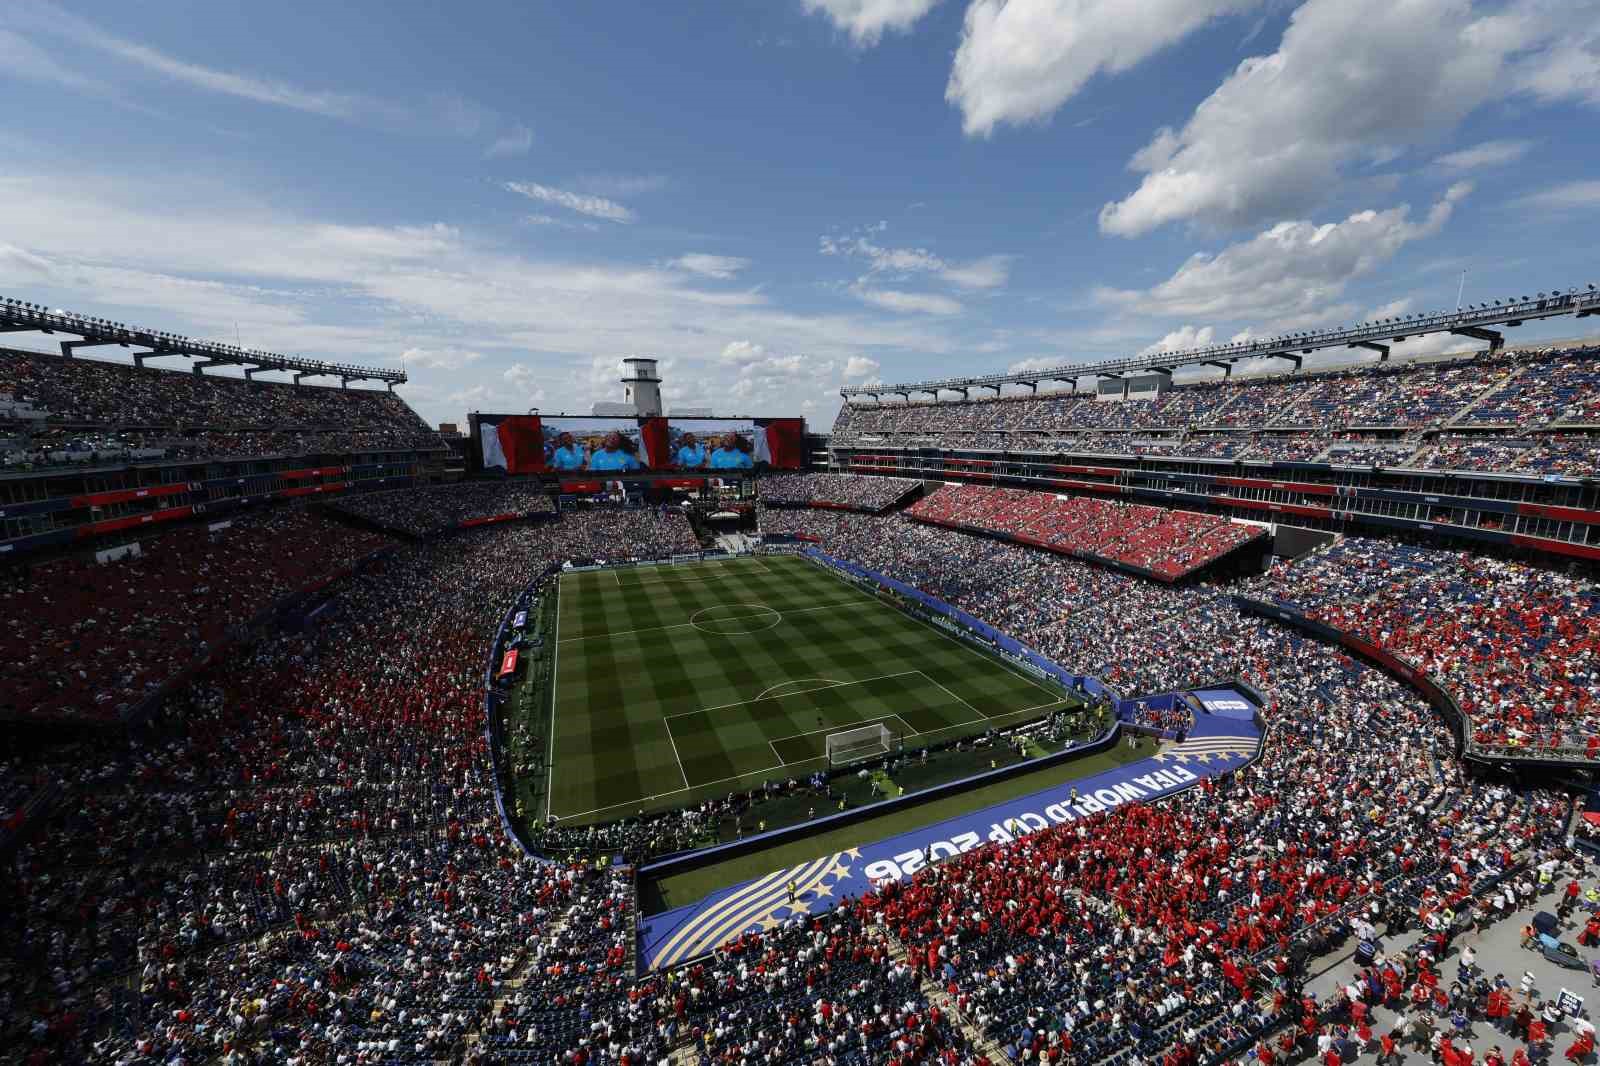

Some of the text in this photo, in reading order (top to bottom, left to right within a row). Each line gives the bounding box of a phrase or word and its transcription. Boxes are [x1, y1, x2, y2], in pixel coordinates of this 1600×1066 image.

[864, 765, 1197, 882] FIFA WORLD CUP 2026
